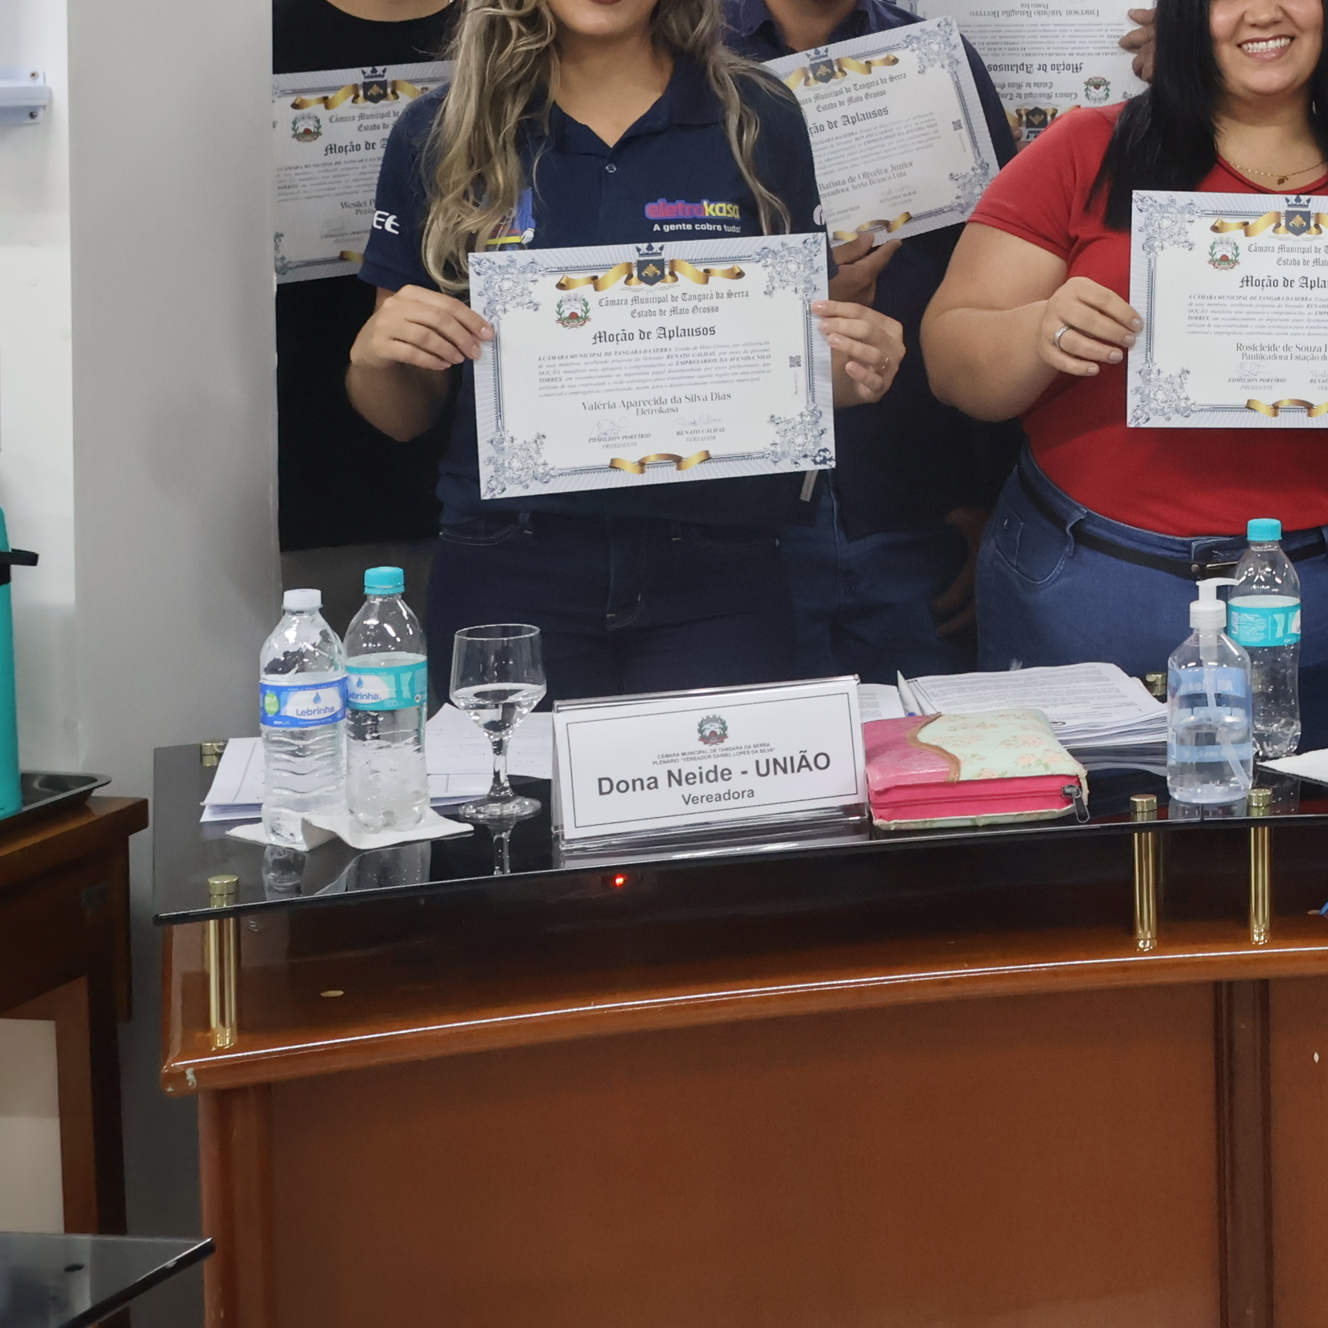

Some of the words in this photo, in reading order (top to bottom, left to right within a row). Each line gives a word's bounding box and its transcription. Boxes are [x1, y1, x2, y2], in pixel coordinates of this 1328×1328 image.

[826, 118, 838, 130] de
[840, 106, 889, 127] Aplausos
[324, 138, 362, 156] Moção
[364, 141, 376, 151] de
[647, 200, 740, 218] eletrokasa
[653, 224, 661, 232] A
[663, 222, 692, 232] gente
[695, 223, 722, 231] cobre
[1247, 243, 1275, 253] Câmara
[1277, 244, 1312, 255] Municipal
[1314, 245, 1322, 255] de
[1276, 257, 1300, 268] Estado
[1302, 258, 1310, 267] de
[1239, 275, 1279, 291] Moção
[1282, 276, 1295, 288] de
[598, 295, 628, 308] Câmara
[630, 293, 668, 306] Municipal
[670, 292, 679, 303] de
[681, 290, 714, 305] Tangará
[716, 290, 724, 300] da
[726, 289, 749, 299] Serra
[630, 306, 657, 318] Estado
[658, 306, 668, 317] de
[591, 329, 636, 346] Moção
[638, 327, 653, 341] de
[655, 325, 716, 340] Aplausos
[1285, 343, 1294, 352] de
[1295, 343, 1322, 353] Souza
[670, 394, 682, 405] da
[711, 391, 732, 402] Dias
[296, 706, 335, 717] Lebrinha
[597, 771, 659, 797] Dona
[666, 763, 733, 789] Neide
[754, 750, 832, 778] UNIÃO
[681, 787, 755, 806] Vereadora
